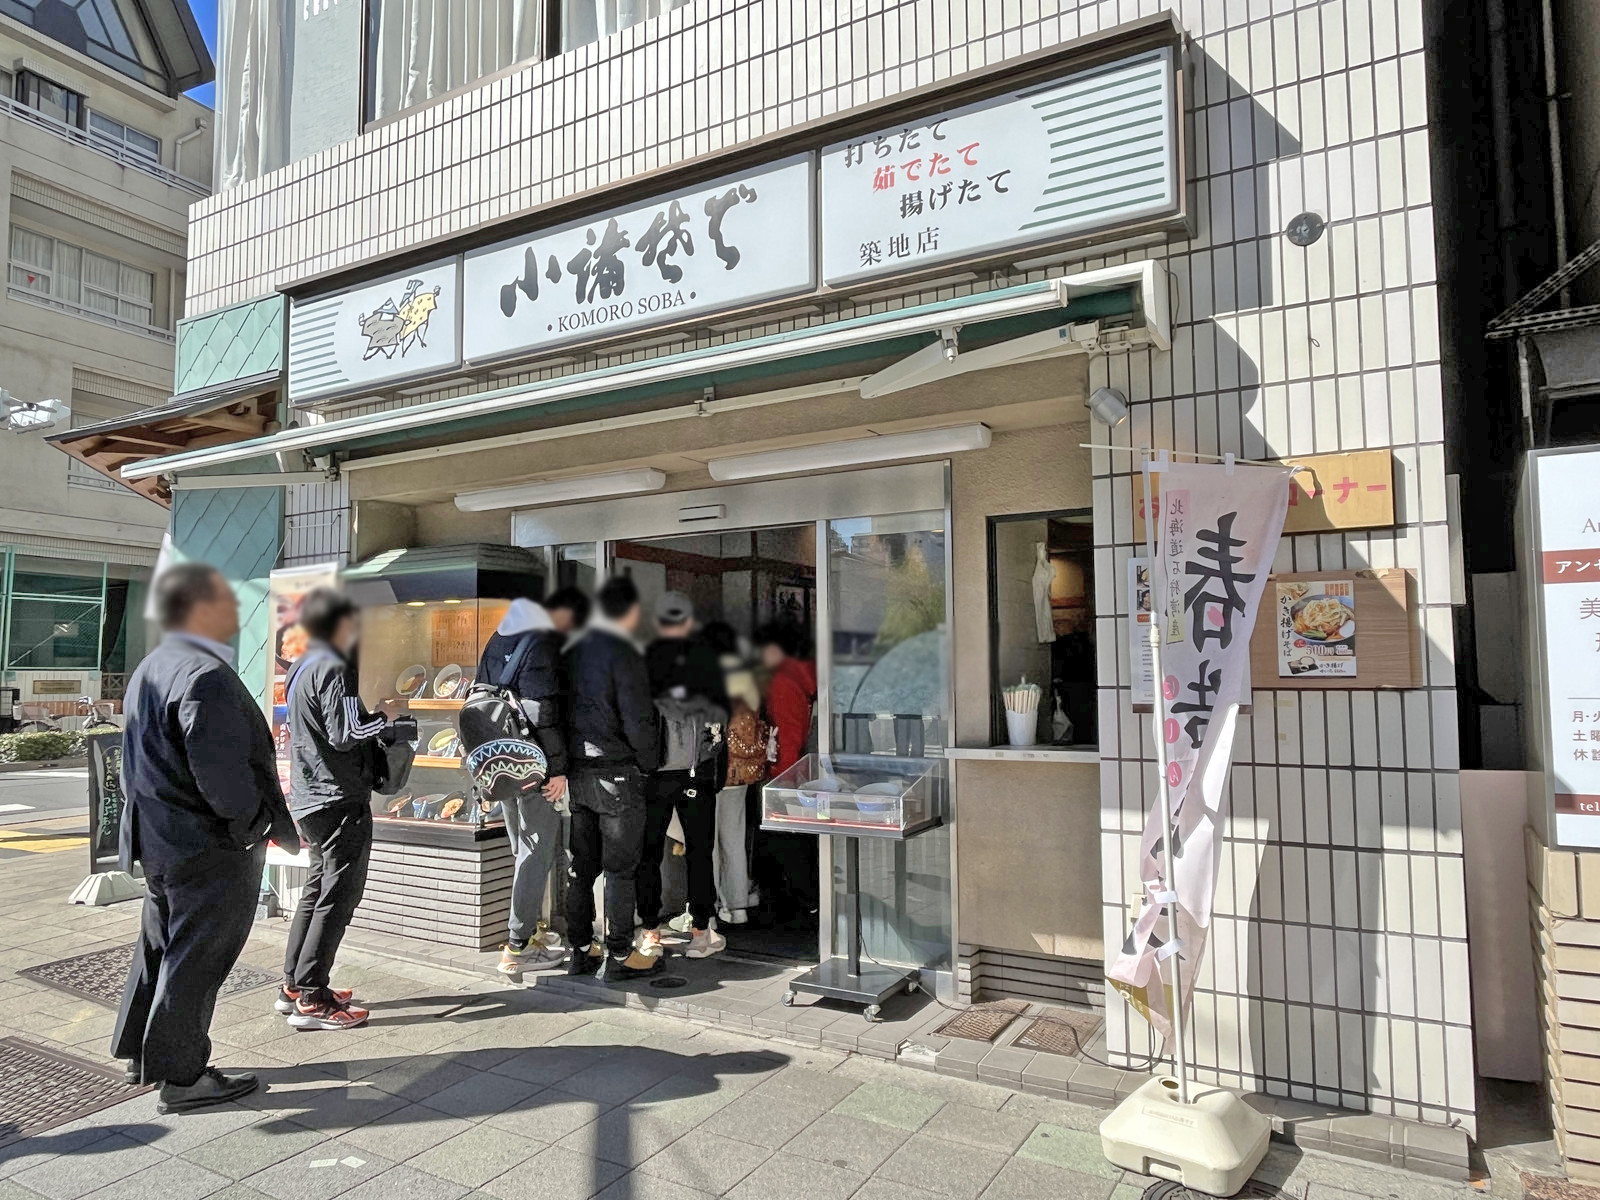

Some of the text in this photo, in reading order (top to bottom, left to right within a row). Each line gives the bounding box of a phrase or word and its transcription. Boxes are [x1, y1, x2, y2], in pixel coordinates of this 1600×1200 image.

[845, 118, 948, 168] 打ちたて
[872, 142, 981, 193] 茹でたて
[900, 169, 1012, 219] 揚げたて
[860, 226, 940, 268] 築地店
[558, 290, 686, 333] KOMORO SOBA
[1582, 518, 1600, 534] A
[1280, 595, 1294, 657] かき揚げそば
